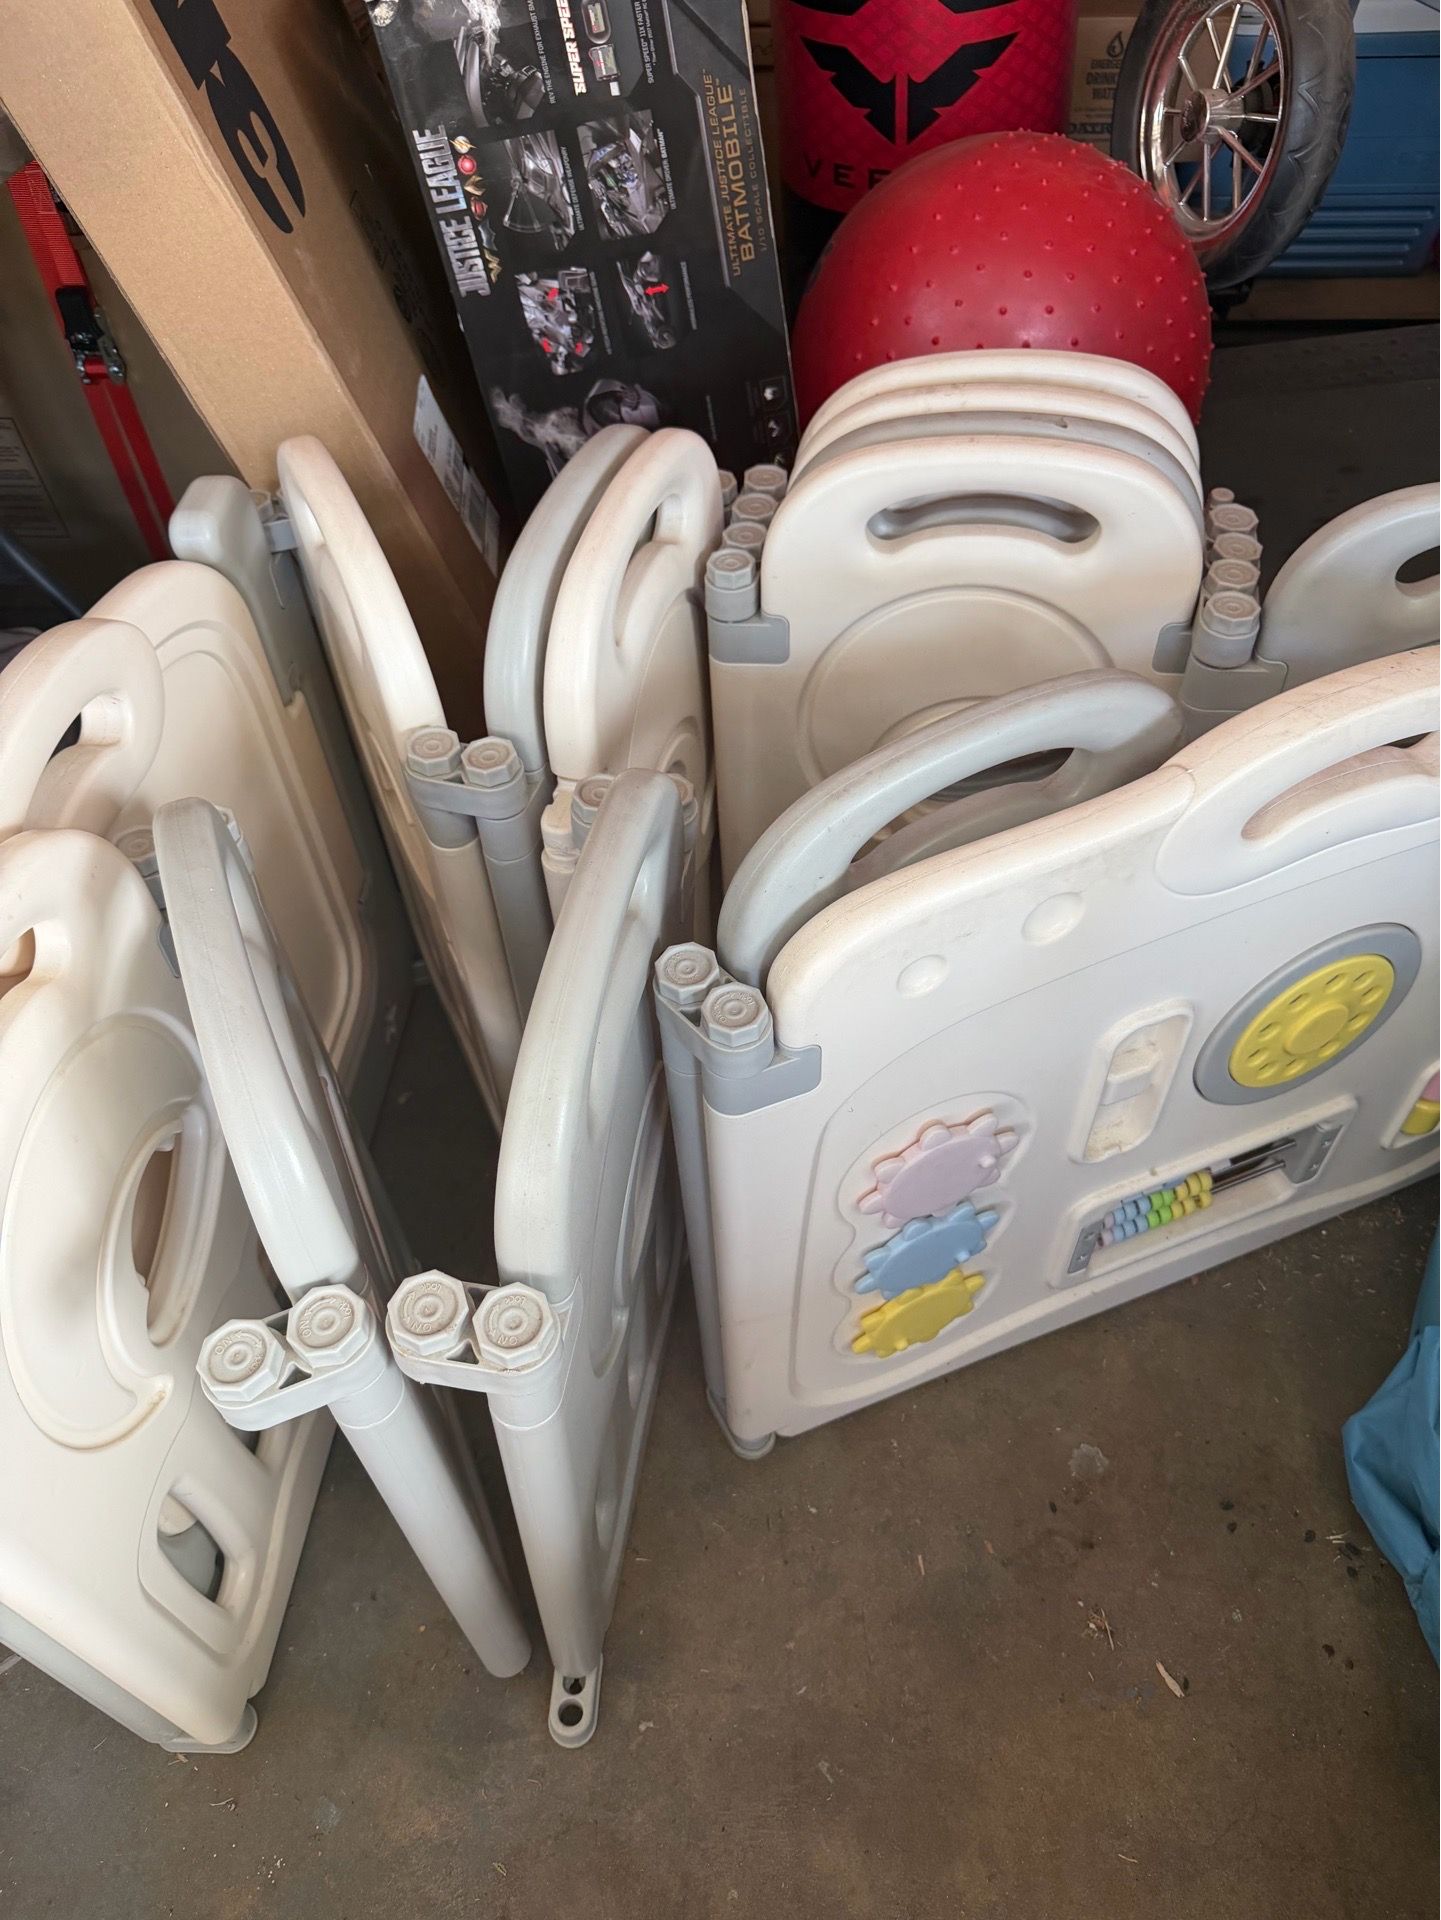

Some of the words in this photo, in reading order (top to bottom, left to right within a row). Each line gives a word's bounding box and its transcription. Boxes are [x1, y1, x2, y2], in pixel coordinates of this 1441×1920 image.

[530, 12, 542, 41] EXHAUST
[634, 1, 644, 26] FASTER
[638, 26, 647, 38] 11X
[540, 55, 550, 79] ENGINE
[565, 41, 587, 96] SUPER
[645, 63, 655, 84] SUPER
[548, 91, 556, 104] REV
[739, 87, 757, 179] COLLECTIBLE
[412, 125, 467, 214] LEAGUE
[560, 146, 573, 179] WEAPONRY
[713, 140, 730, 201] JUSTICE
[567, 178, 578, 204] DEFENSE
[666, 182, 677, 210] ULTIMATE
[752, 184, 763, 223] SCALE
[573, 204, 585, 230] ULTIMATE
[723, 206, 741, 276] ULTIMATE
[758, 227, 768, 251] 1/10
[439, 216, 491, 298] JUSTICE
[300, 1319, 312, 1337] ON
[411, 1321, 432, 1332] ON
[214, 1334, 233, 1354] ON
[498, 1335, 518, 1345] ON
